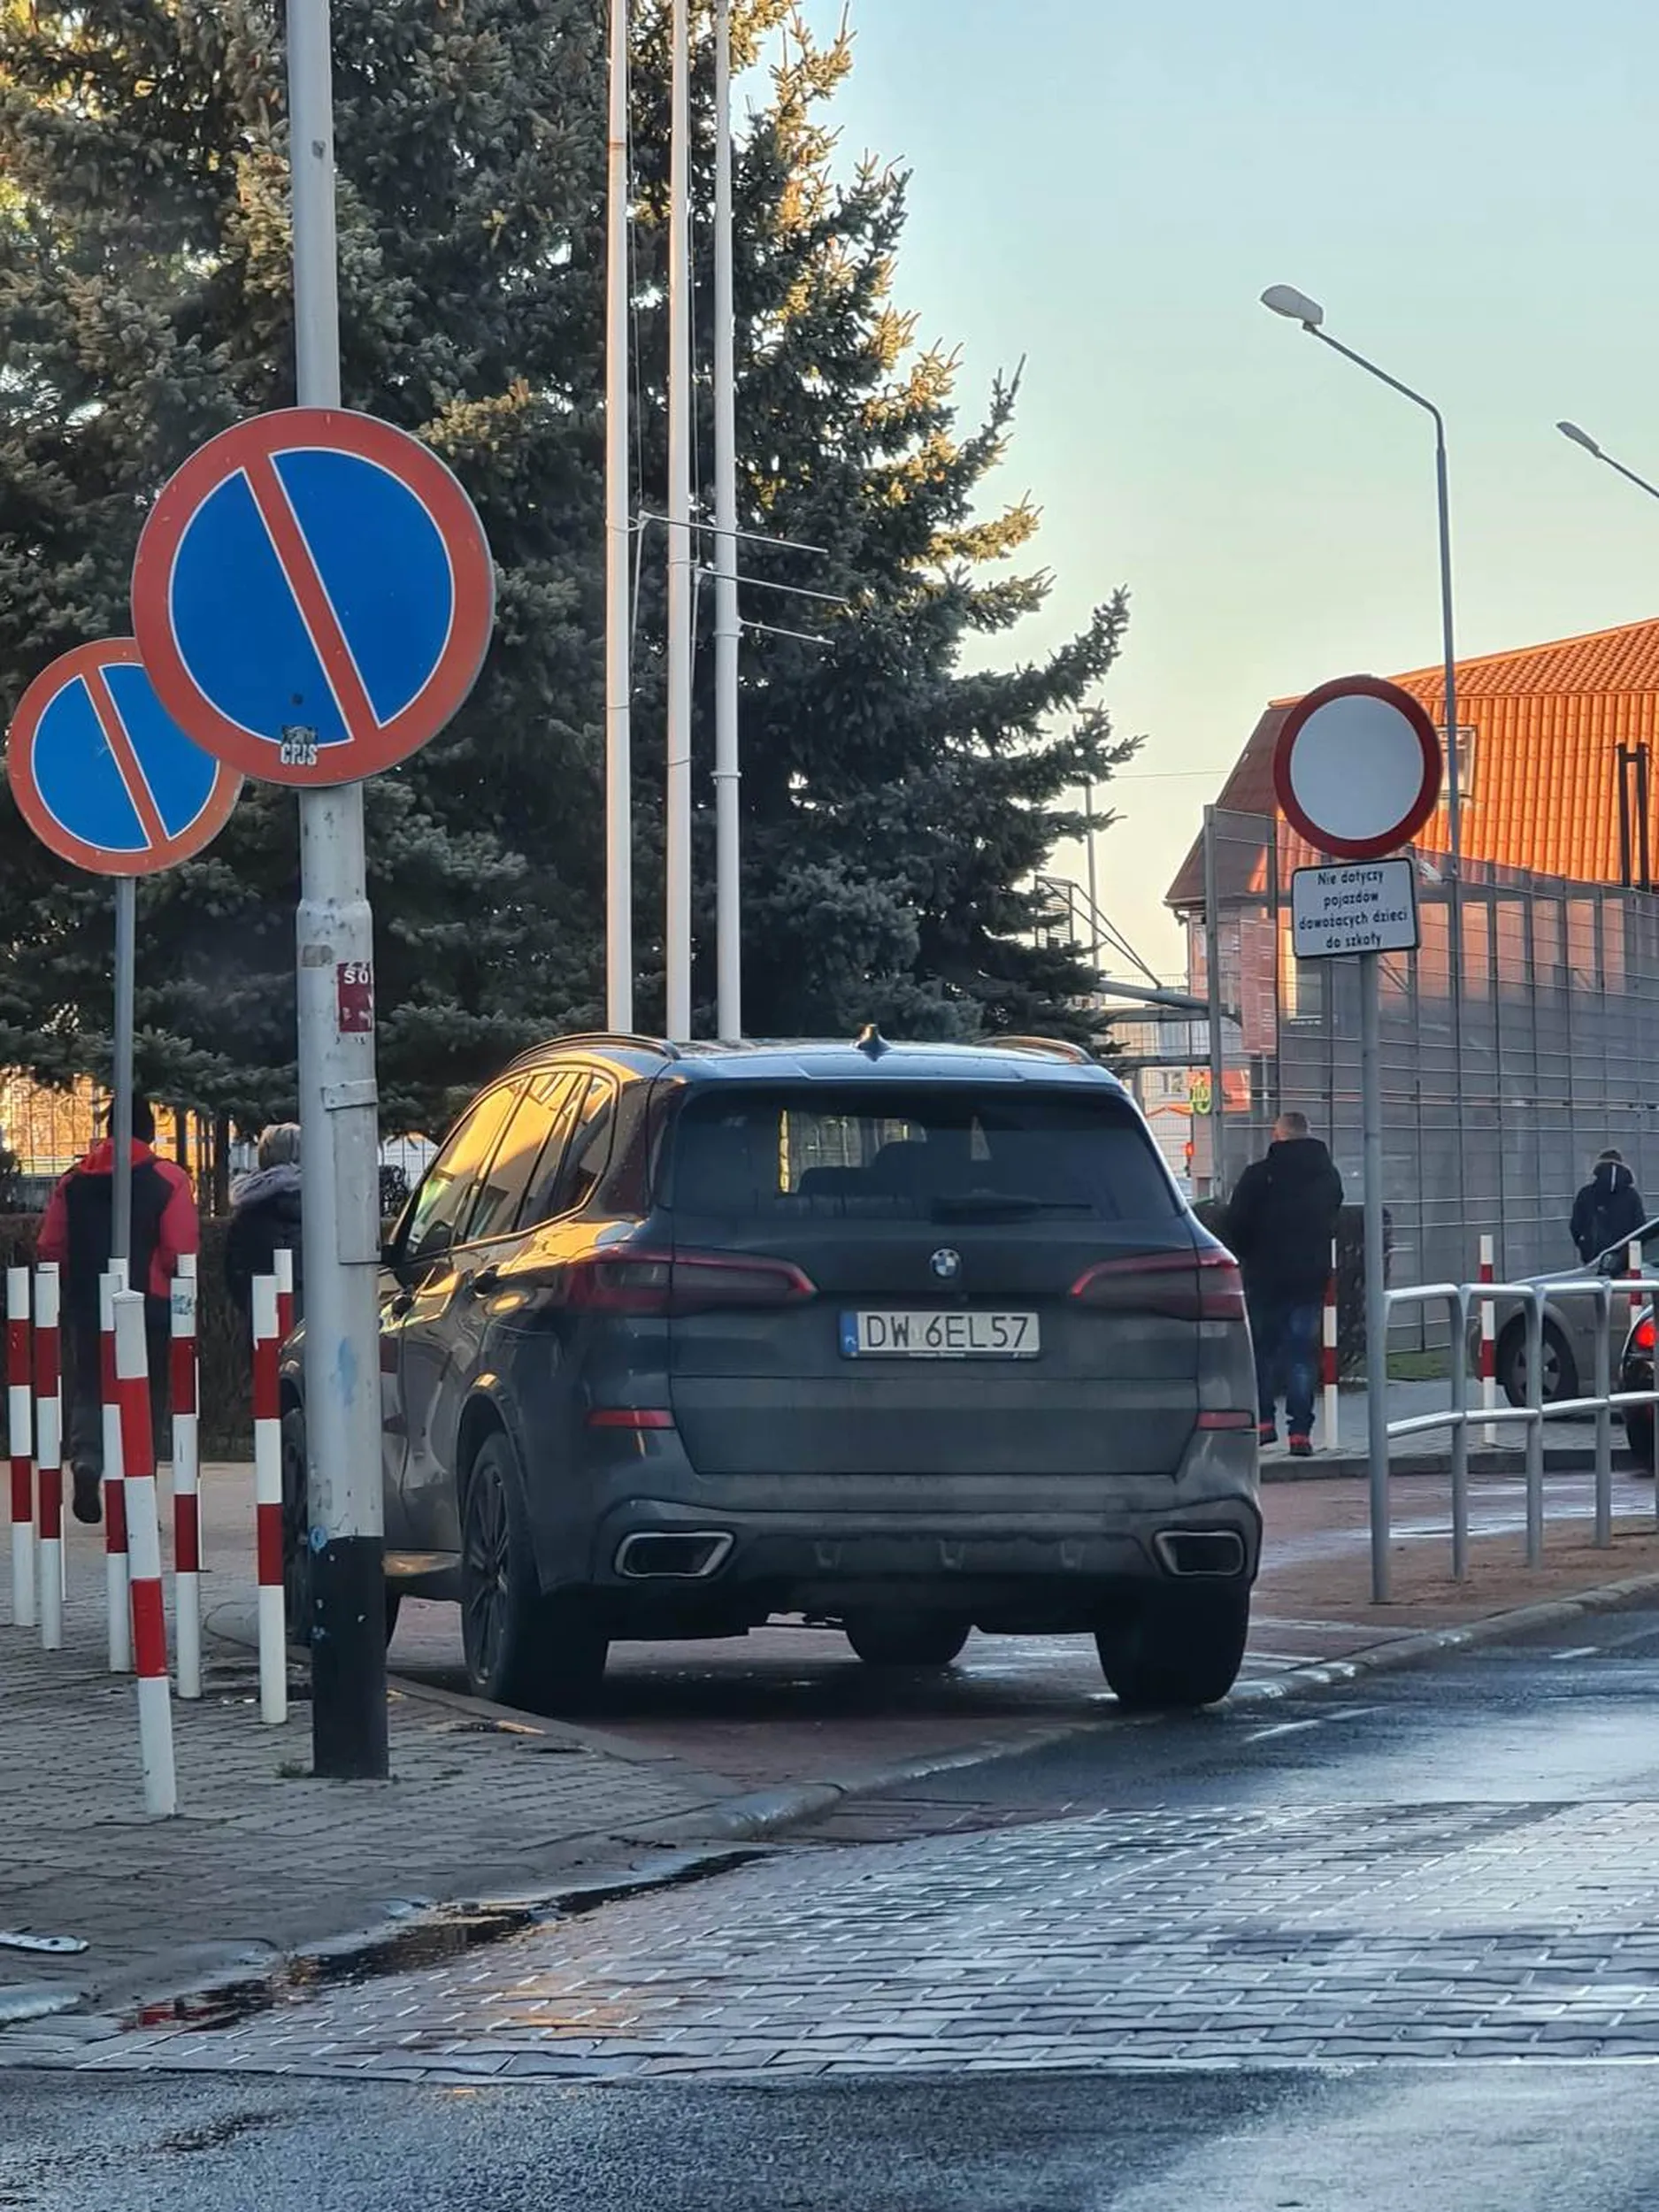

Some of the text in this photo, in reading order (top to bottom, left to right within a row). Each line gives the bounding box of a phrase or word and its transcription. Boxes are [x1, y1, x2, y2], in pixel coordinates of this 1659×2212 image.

[1317, 870, 1384, 886] Nie dotyczy
[1372, 908, 1408, 923] dzieci
[1325, 932, 1382, 949] do szkoły
[866, 1315, 1029, 1348] DW 6EL57
